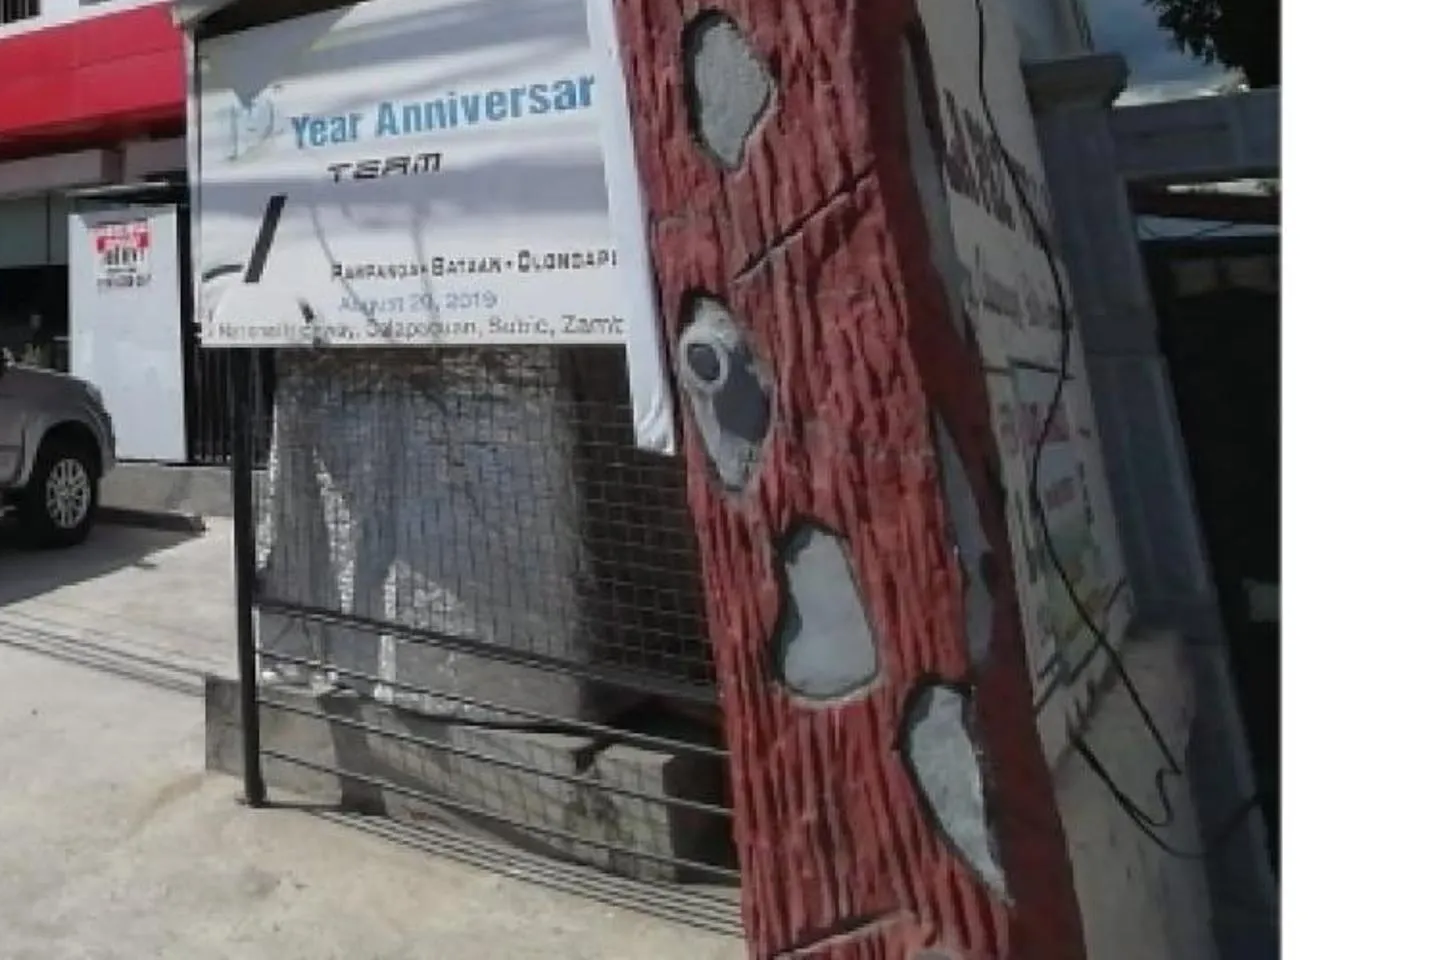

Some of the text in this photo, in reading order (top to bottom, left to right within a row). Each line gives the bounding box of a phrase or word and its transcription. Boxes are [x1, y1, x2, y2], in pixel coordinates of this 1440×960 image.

[290, 113, 363, 149] Year
[327, 152, 443, 182] TEAM
[446, 290, 498, 311] 2019
